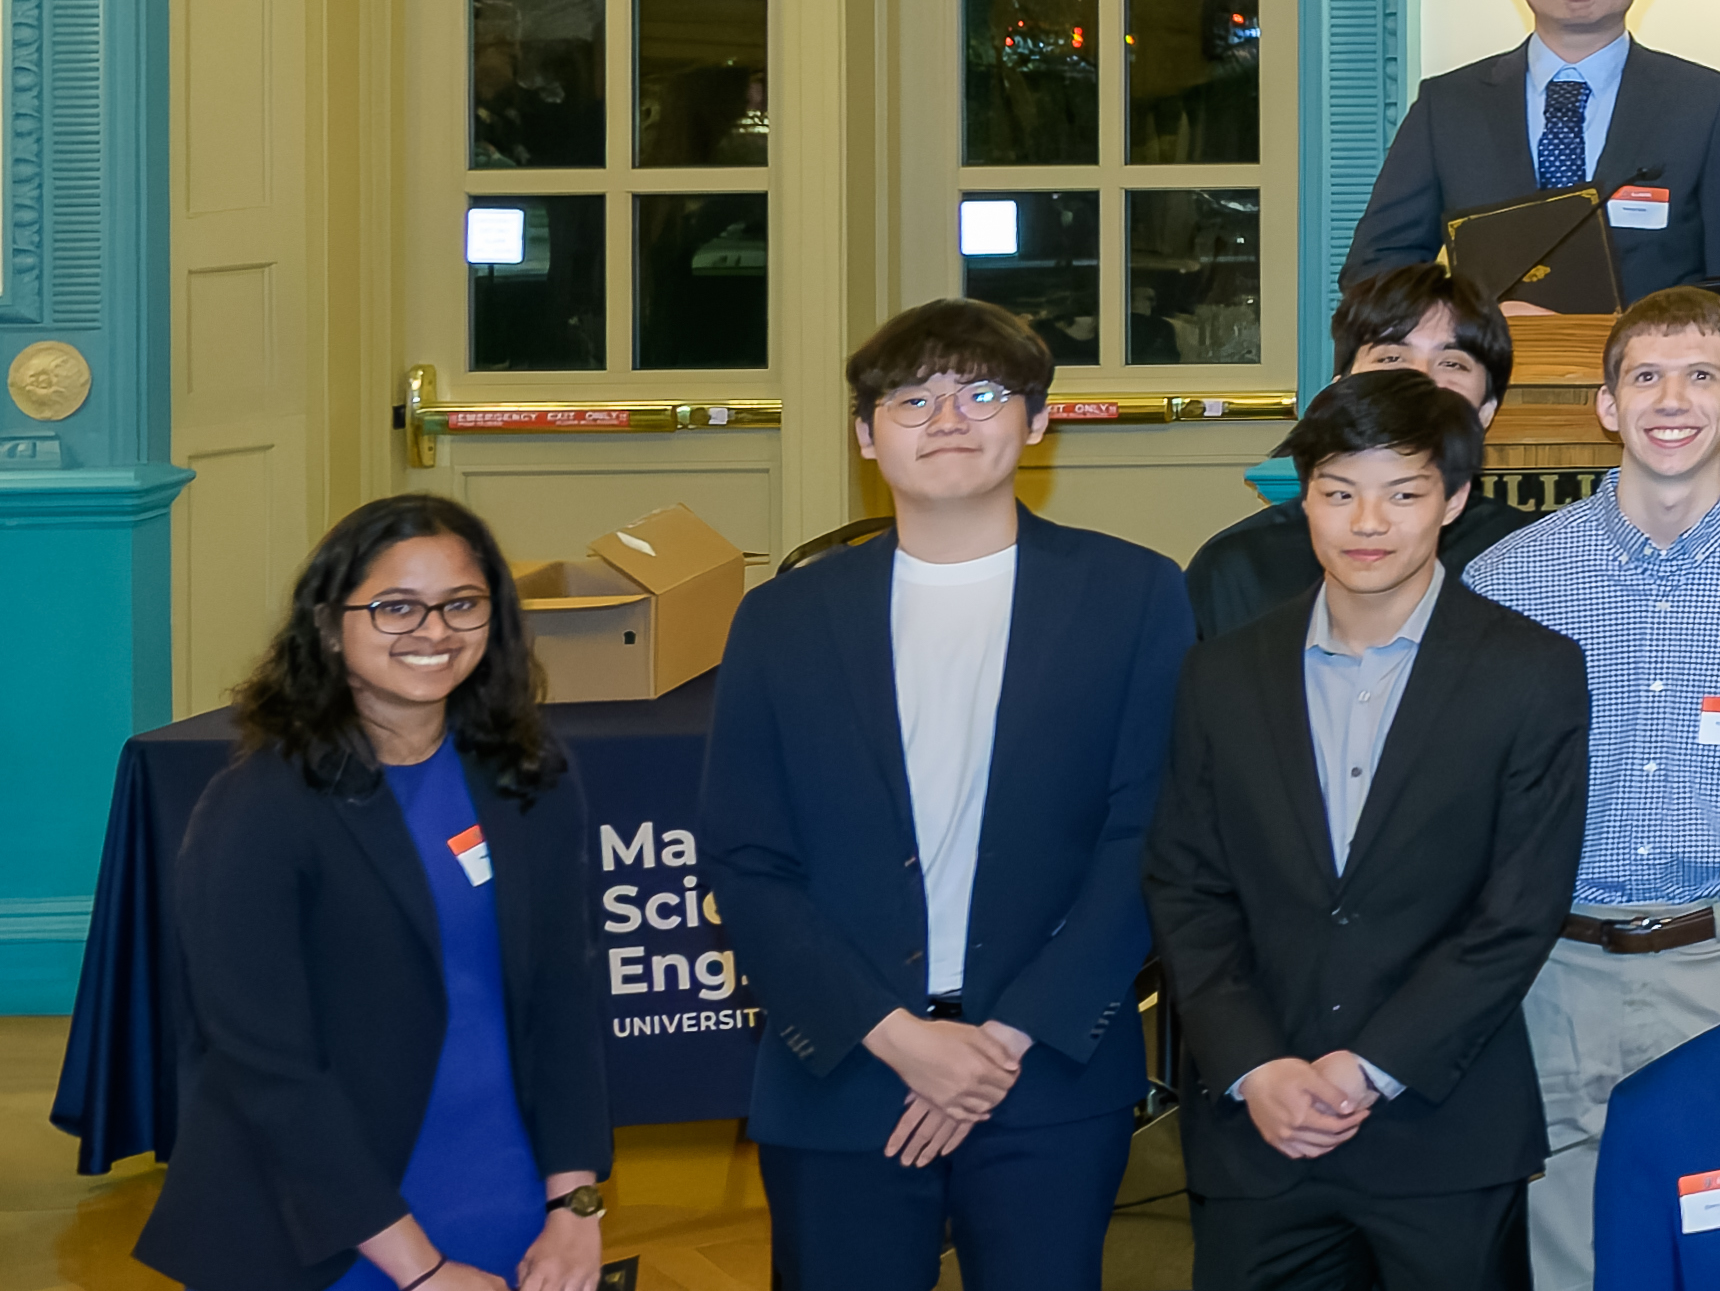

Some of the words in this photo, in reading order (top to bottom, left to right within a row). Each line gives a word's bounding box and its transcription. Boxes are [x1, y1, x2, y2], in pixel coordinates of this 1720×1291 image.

[1075, 403, 1109, 414] ONLY
[457, 412, 539, 422] EMERGENCY
[546, 411, 576, 421] EXIT
[585, 411, 618, 421] ONLY
